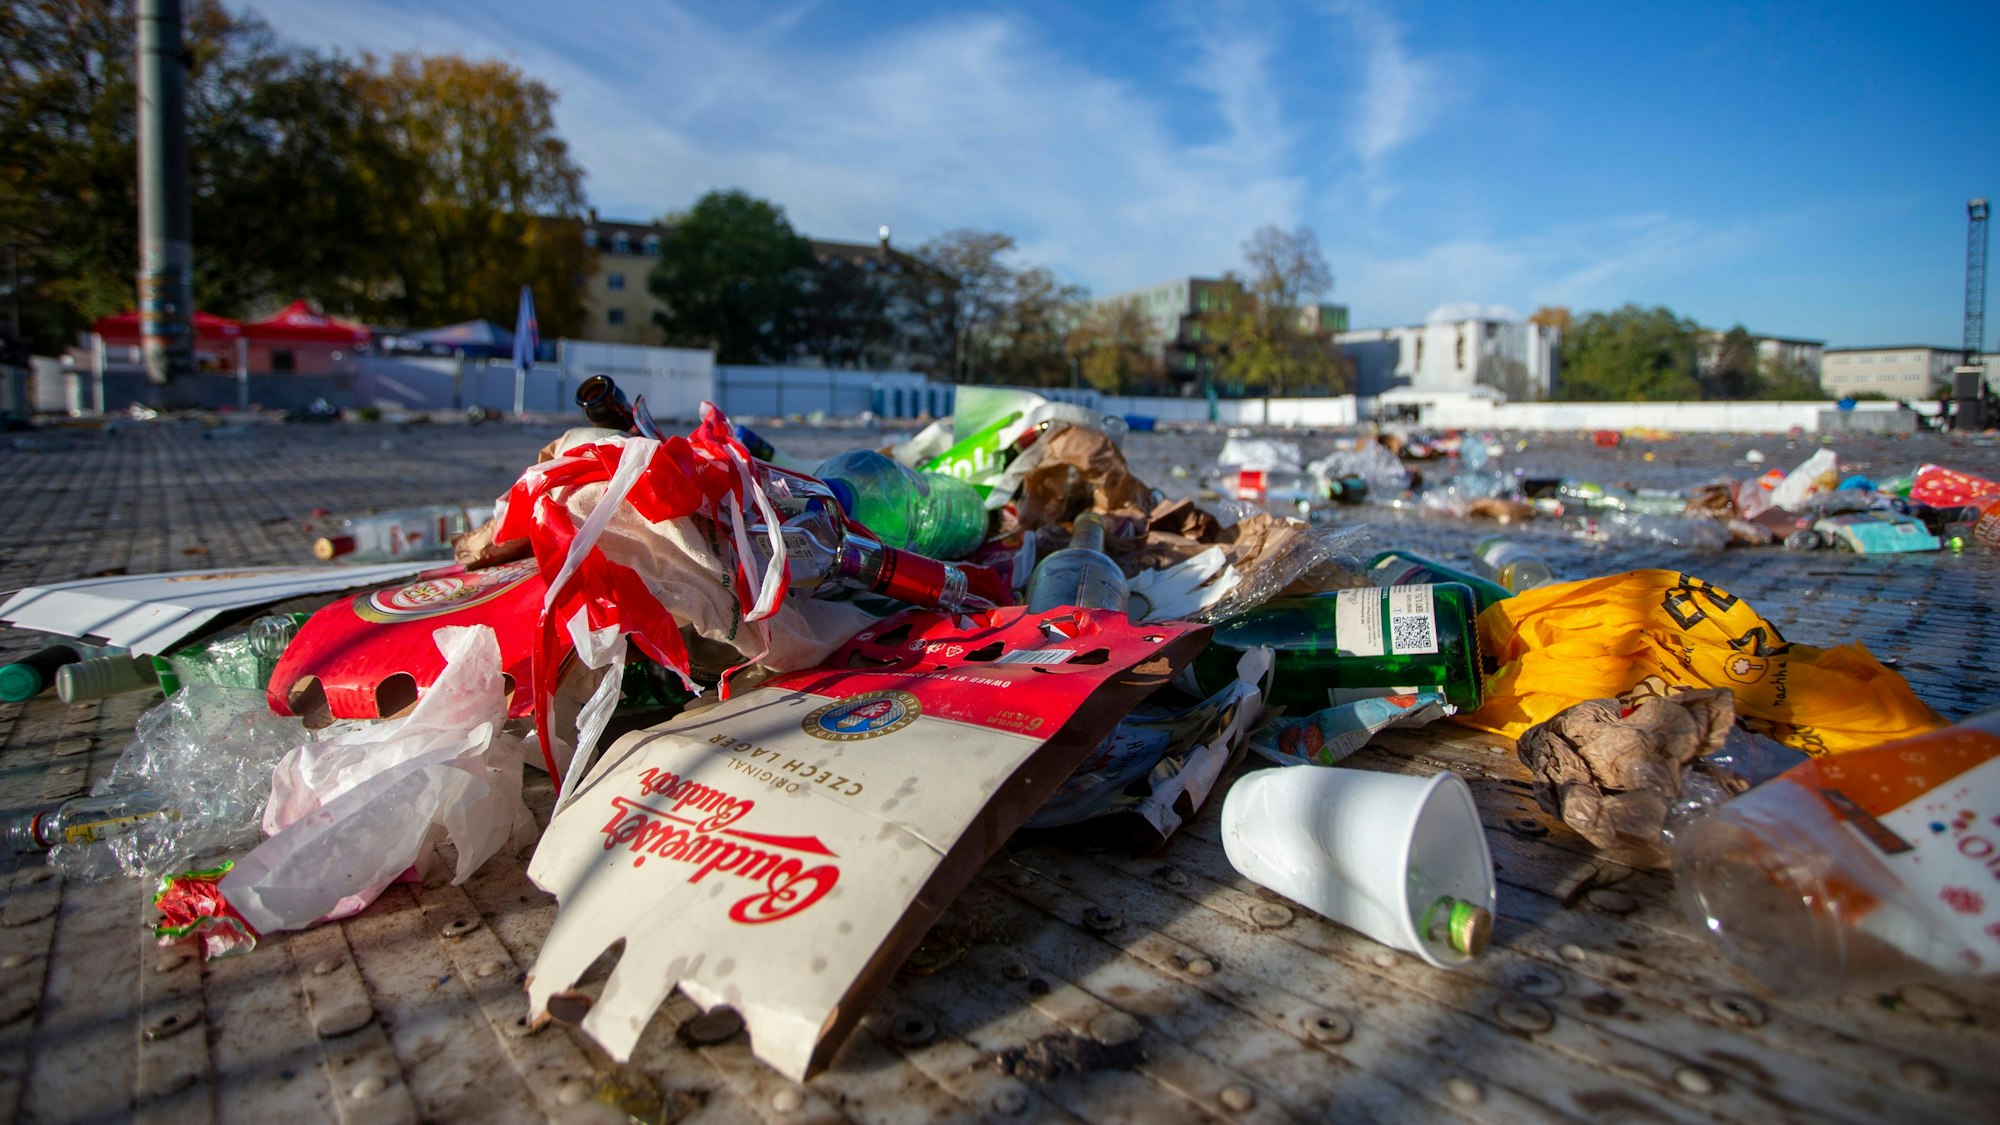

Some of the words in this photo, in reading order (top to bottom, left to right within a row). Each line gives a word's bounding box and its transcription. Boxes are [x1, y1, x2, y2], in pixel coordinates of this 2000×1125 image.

[969, 676, 1011, 688] OWNED
[1025, 716, 1044, 731] 6
[708, 732, 782, 768] LAGER
[726, 757, 801, 793] ORIGINAL
[780, 758, 865, 797] CZECH
[636, 766, 755, 832] Budvar
[597, 805, 841, 925] Budweiser
